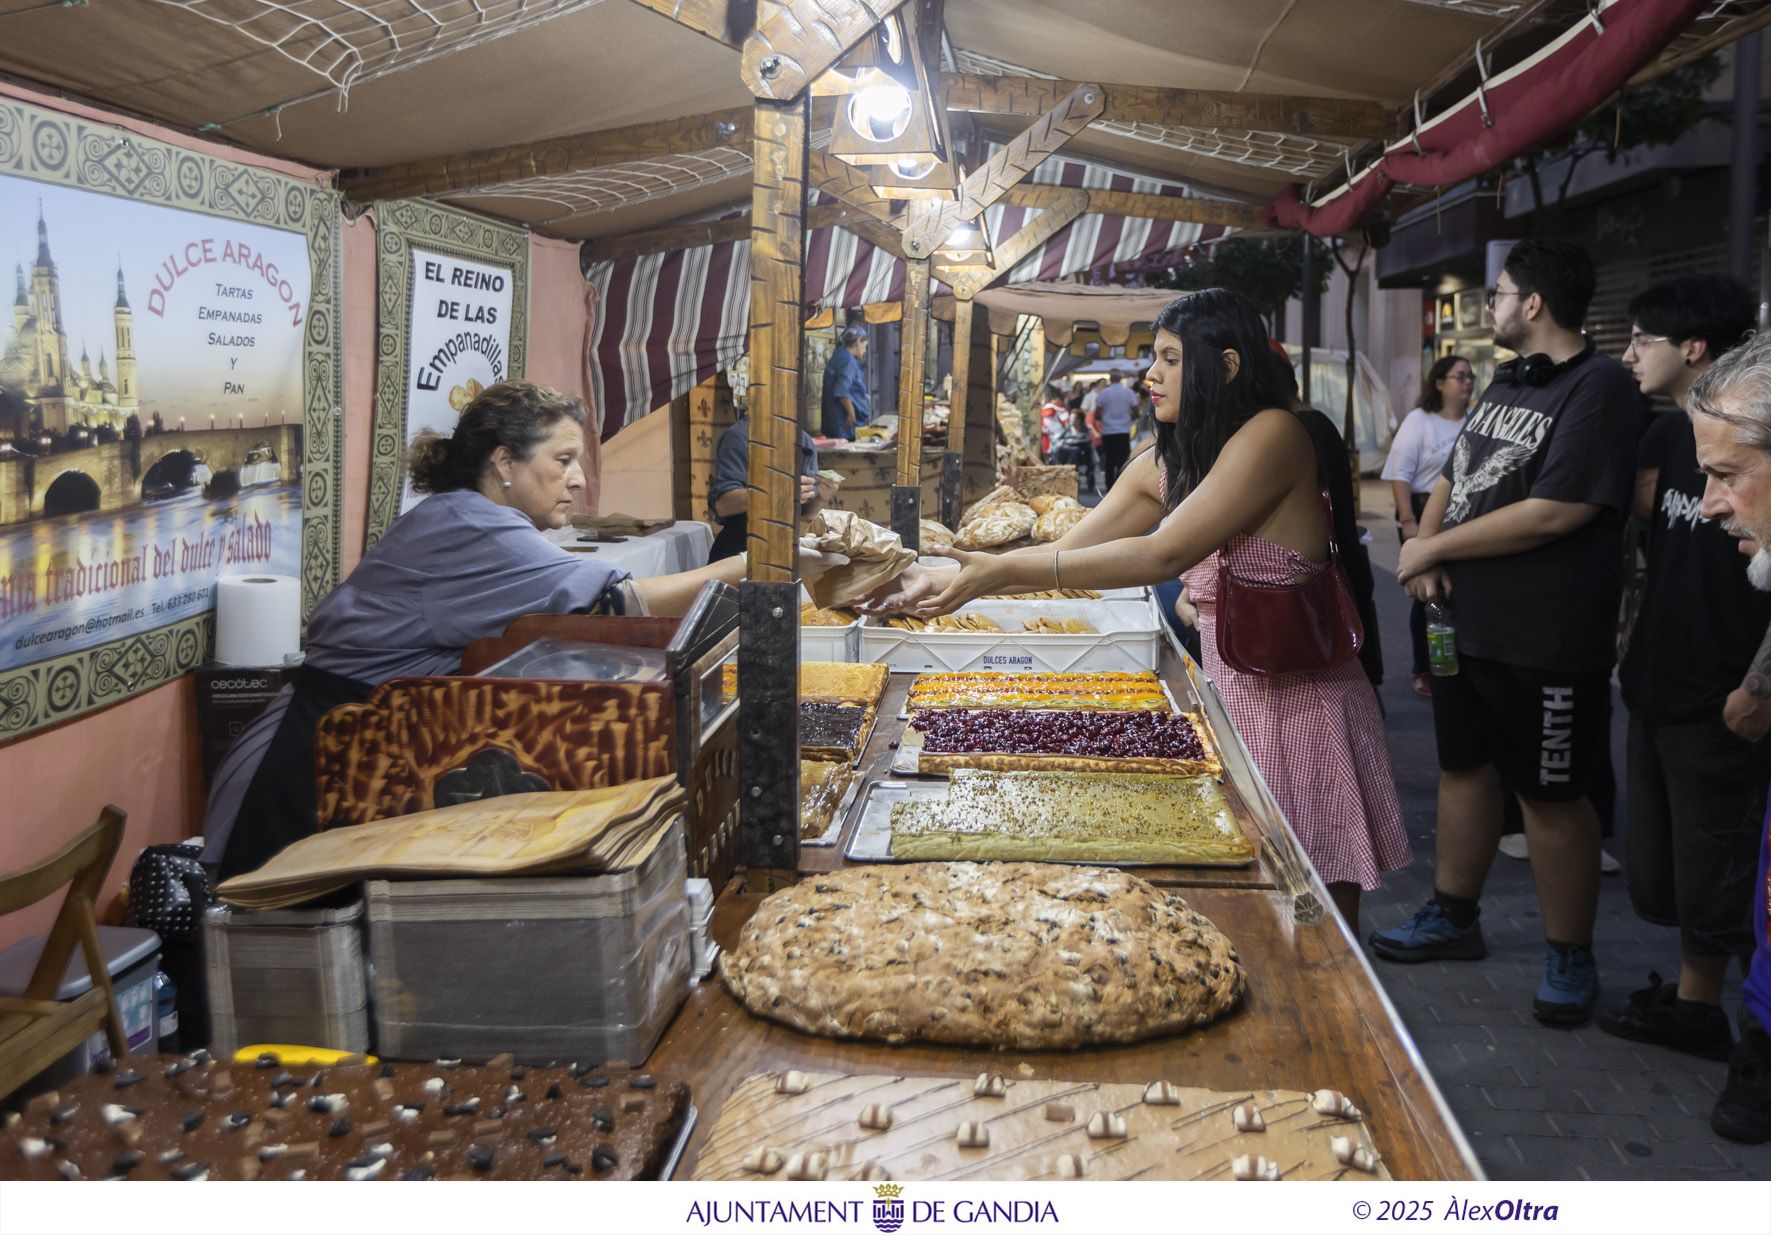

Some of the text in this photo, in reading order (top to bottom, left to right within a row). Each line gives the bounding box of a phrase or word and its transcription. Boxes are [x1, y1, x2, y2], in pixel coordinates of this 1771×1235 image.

[147, 238, 303, 328] DULCE ARAGON
[425, 261, 505, 292] EL REINO
[215, 283, 254, 300] TARTAS
[198, 306, 263, 324] EMPANADAS
[437, 299, 498, 324] DE LAS
[208, 332, 256, 347] SALADOS
[230, 358, 238, 370] Y
[223, 382, 245, 395] PAN
[45, 544, 148, 606] tradicional
[153, 537, 177, 579] del
[180, 530, 215, 573] dulce
[226, 510, 271, 564] salado
[15, 608, 145, 650] dulcearagon@hotmail.es
[152, 602, 165, 614] Tel.
[983, 656, 1032, 665] DULCES ARAGON
[1539, 687, 1573, 786] TENTH
